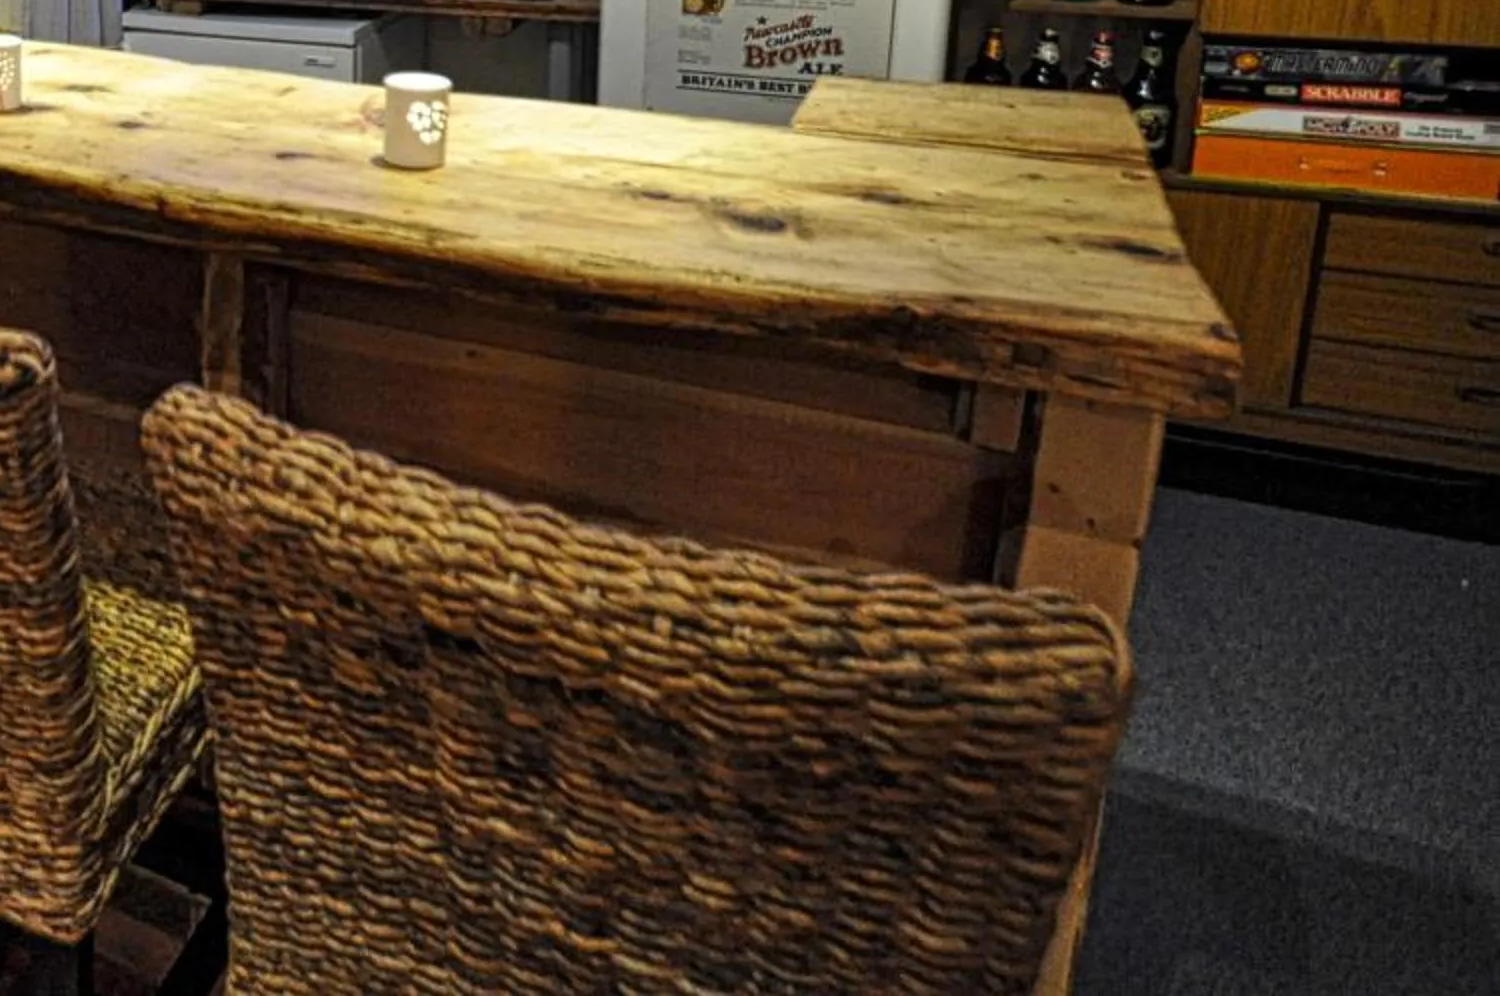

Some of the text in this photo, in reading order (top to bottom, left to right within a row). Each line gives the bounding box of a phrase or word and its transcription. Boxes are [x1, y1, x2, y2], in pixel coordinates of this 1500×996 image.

[765, 26, 834, 48] CHAMPION
[743, 37, 844, 69] Brown
[798, 61, 843, 75] ALE
[681, 74, 755, 91] BRITAIN'S
[759, 80, 795, 93] BEST
[1303, 83, 1399, 103] SCRABBLE
